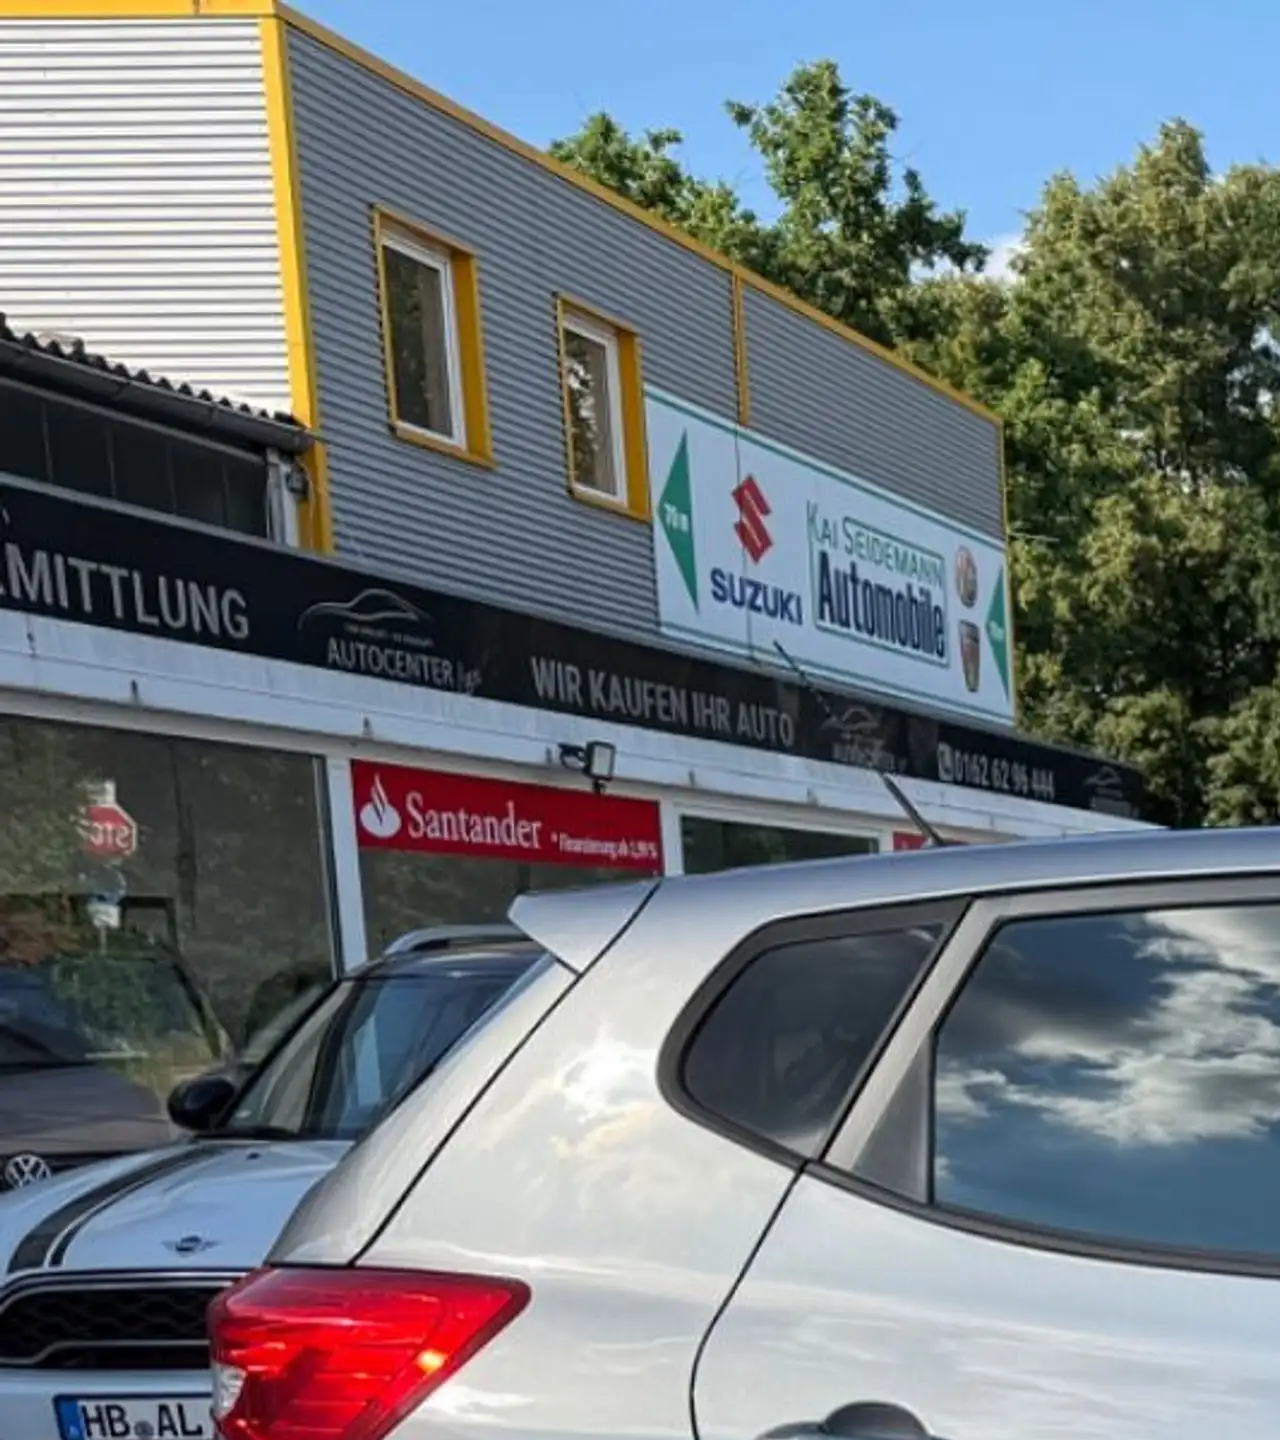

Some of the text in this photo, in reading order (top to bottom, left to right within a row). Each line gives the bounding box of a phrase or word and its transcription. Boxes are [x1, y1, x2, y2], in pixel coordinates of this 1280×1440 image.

[0, 542, 250, 640] MITTLUNG
[709, 566, 803, 626] SUZUKI
[818, 549, 946, 658] Automobile
[327, 636, 454, 688] AUTOCENTER
[530, 655, 583, 708] WIR
[588, 668, 689, 727] KAUFEN
[690, 691, 733, 734] IHR
[736, 702, 796, 748] AUTO
[405, 790, 543, 850] Santander
[81, 1402, 204, 1438] HB AL
